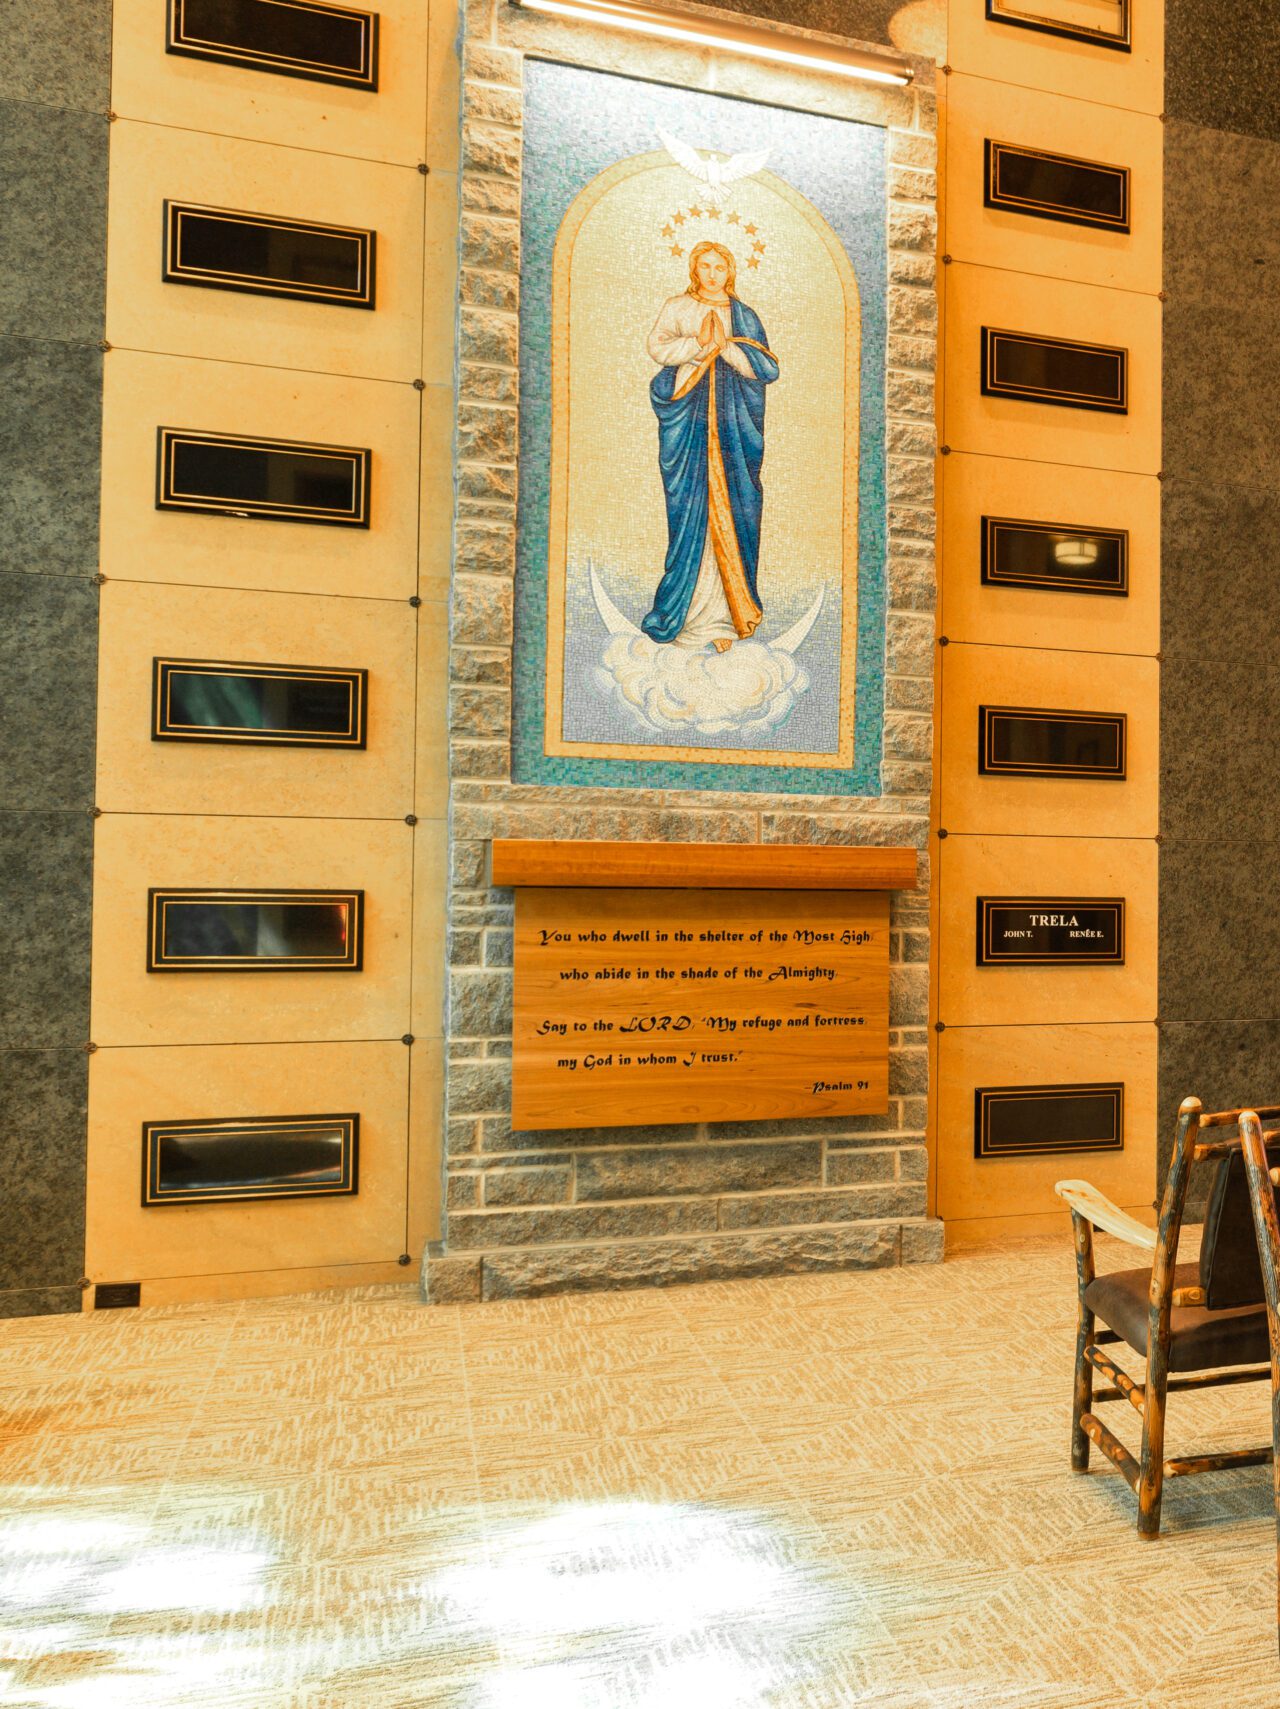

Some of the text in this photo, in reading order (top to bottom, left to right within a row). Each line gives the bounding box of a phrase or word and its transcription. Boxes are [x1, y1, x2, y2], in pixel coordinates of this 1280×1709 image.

[1029, 914, 1079, 927] TRELA
[537, 929, 571, 946] You
[578, 930, 607, 943] who
[613, 930, 650, 942] dwell
[656, 930, 669, 942] in
[674, 930, 694, 943] the
[699, 930, 744, 943] shelter
[749, 930, 764, 942] of
[769, 930, 788, 943] the
[793, 930, 835, 945] Most
[1003, 930, 1033, 938] JOHN T.
[1069, 928, 1105, 938] RENÉE E.
[560, 968, 590, 981] who
[595, 968, 631, 980] abide
[637, 968, 650, 980] in
[655, 967, 675, 980] the
[681, 967, 719, 979] shade
[724, 967, 738, 979] of
[744, 967, 763, 979] the
[536, 1020, 567, 1035] Say
[573, 1021, 587, 1032] to
[593, 1019, 614, 1032] the
[619, 1015, 695, 1033] LORD,
[742, 1015, 782, 1031] refuge
[787, 1015, 810, 1027] and
[557, 1059, 577, 1071] my
[583, 1054, 613, 1071] God
[618, 1054, 631, 1067] in
[637, 1053, 677, 1066] whom
[682, 1051, 696, 1068] I
[857, 1080, 869, 1090] 91
